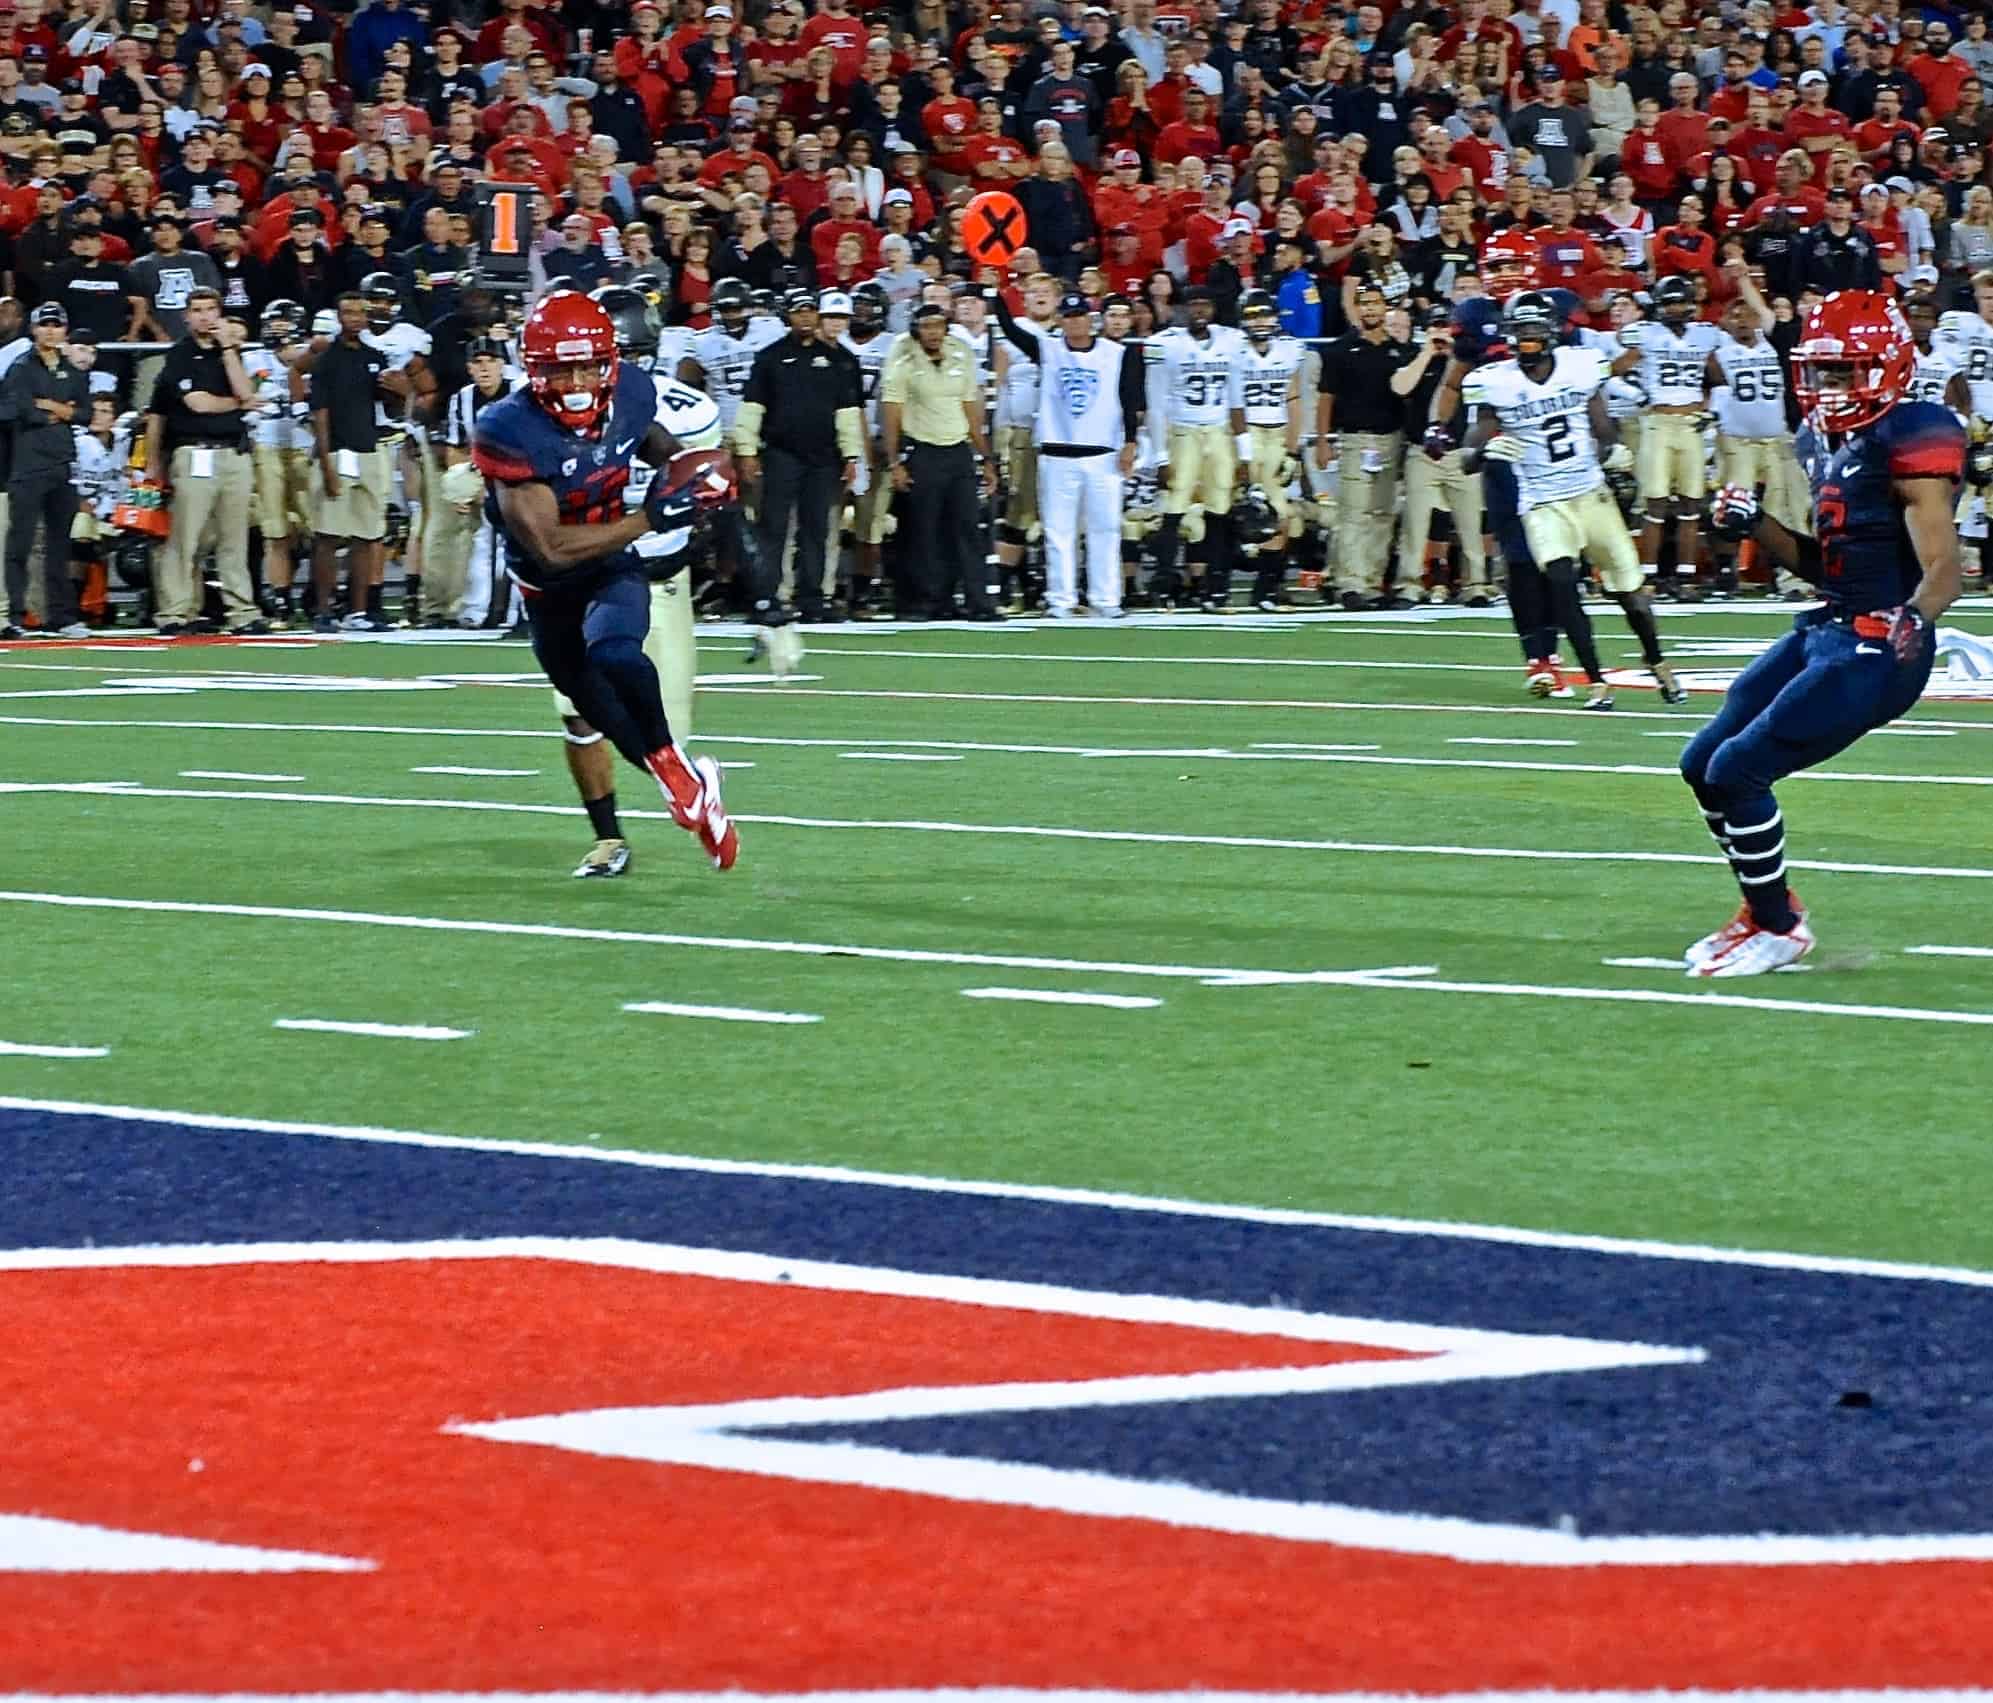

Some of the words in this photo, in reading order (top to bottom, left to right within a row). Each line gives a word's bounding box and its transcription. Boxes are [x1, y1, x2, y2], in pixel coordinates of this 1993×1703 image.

[490, 192, 519, 253] 1
[978, 204, 1016, 255] X
[1185, 374, 1226, 406] 37
[1658, 362, 1705, 387] 23
[1735, 369, 1781, 401] 65
[662, 388, 704, 411] 41
[1244, 383, 1285, 407] 25
[1543, 414, 1575, 463] 2
